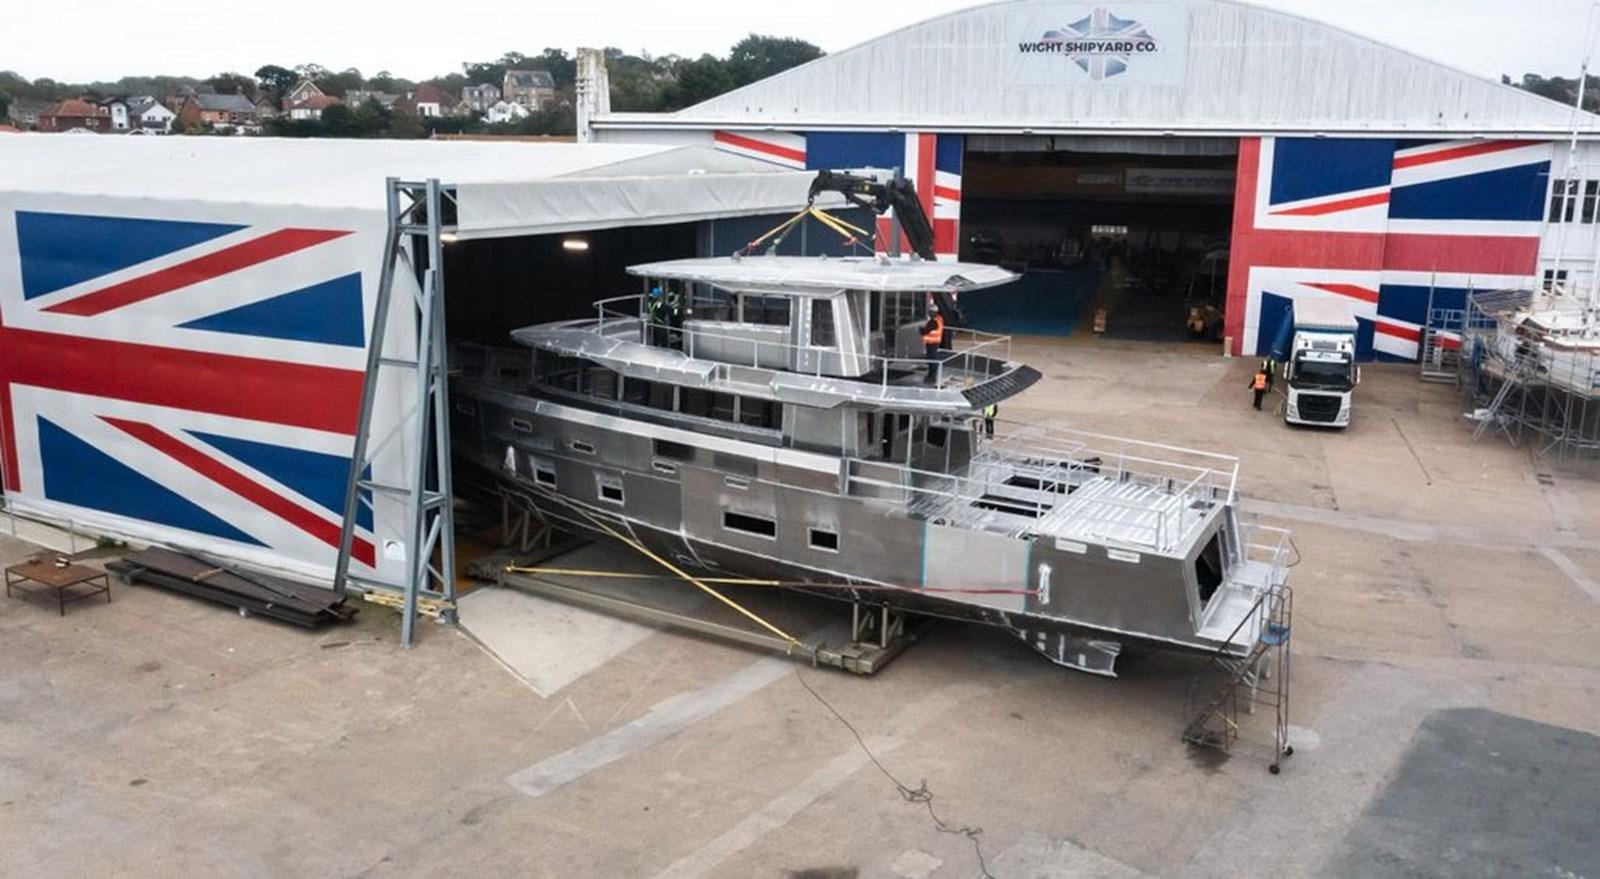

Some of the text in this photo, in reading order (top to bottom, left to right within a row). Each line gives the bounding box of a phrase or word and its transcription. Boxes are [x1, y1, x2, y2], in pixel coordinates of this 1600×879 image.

[1019, 41, 1159, 53] WIGHT SHIPYARD CO.
